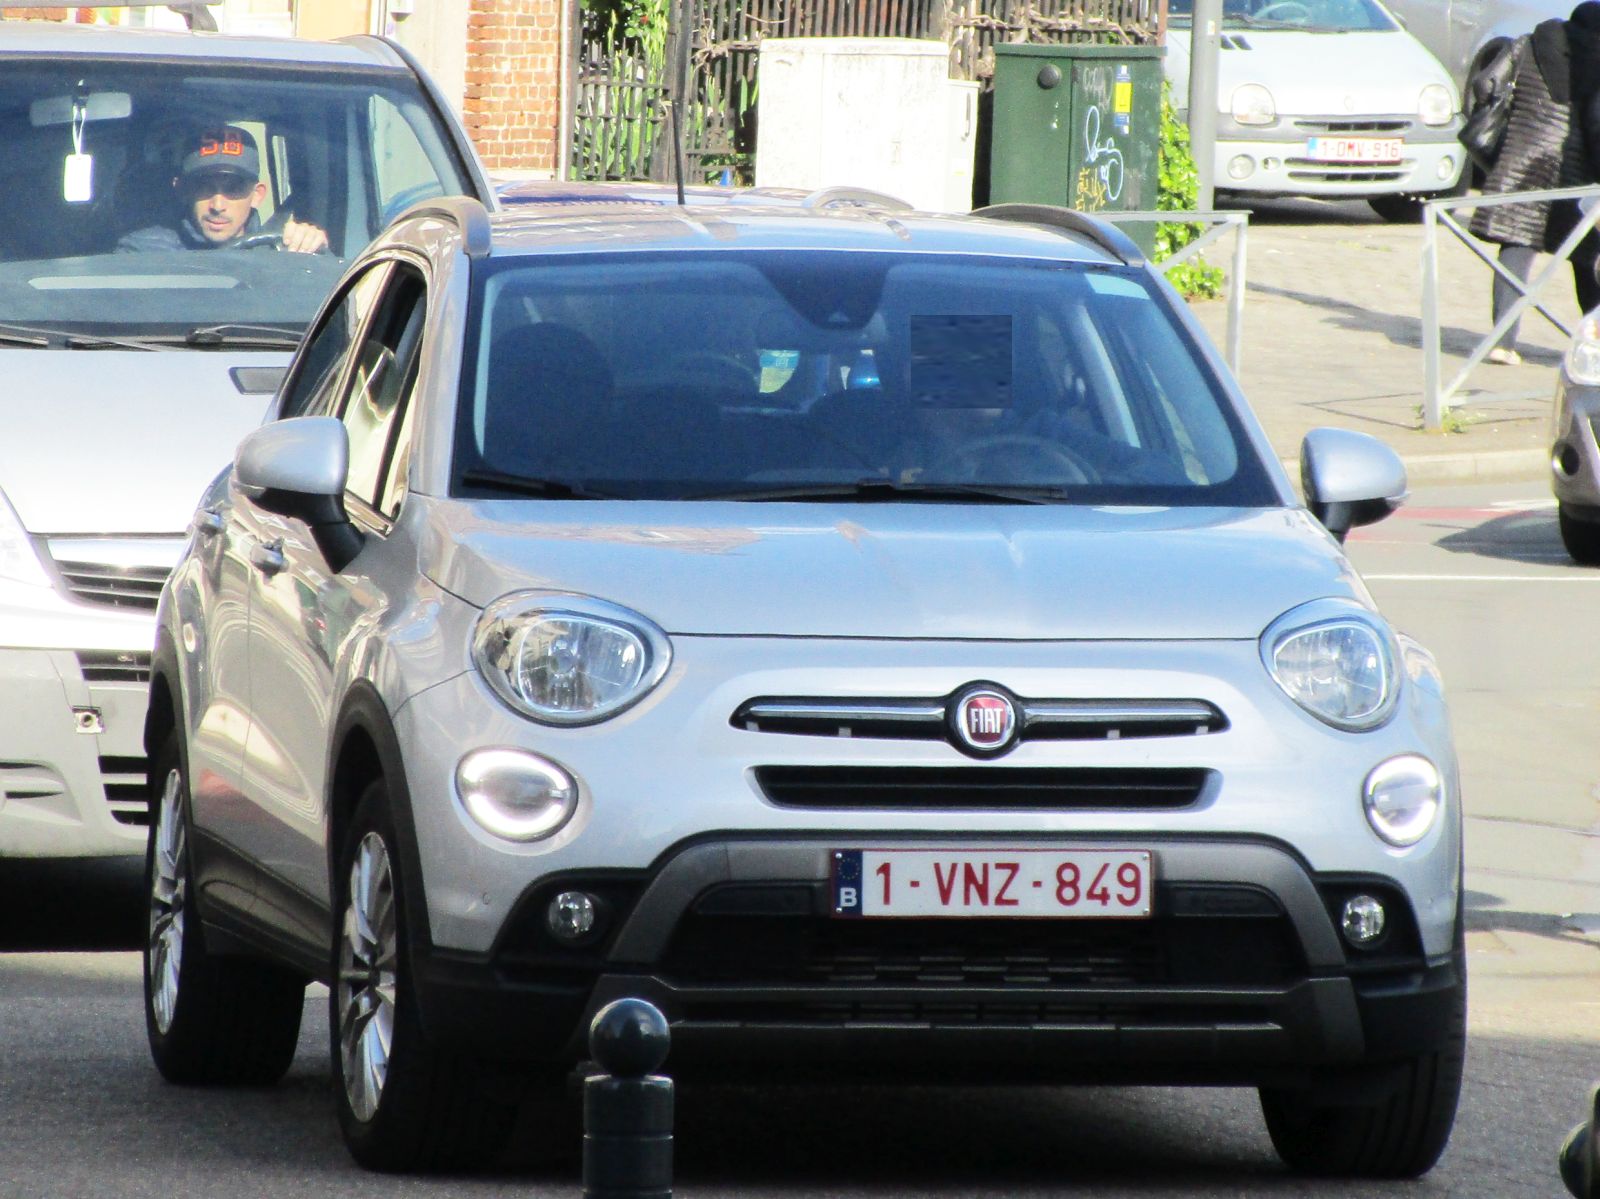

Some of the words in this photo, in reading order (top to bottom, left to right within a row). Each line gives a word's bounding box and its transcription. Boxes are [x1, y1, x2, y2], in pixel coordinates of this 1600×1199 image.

[970, 707, 1003, 733] FIAT
[839, 887, 857, 907] B
[876, 862, 1141, 906] 1-VNZ-849
